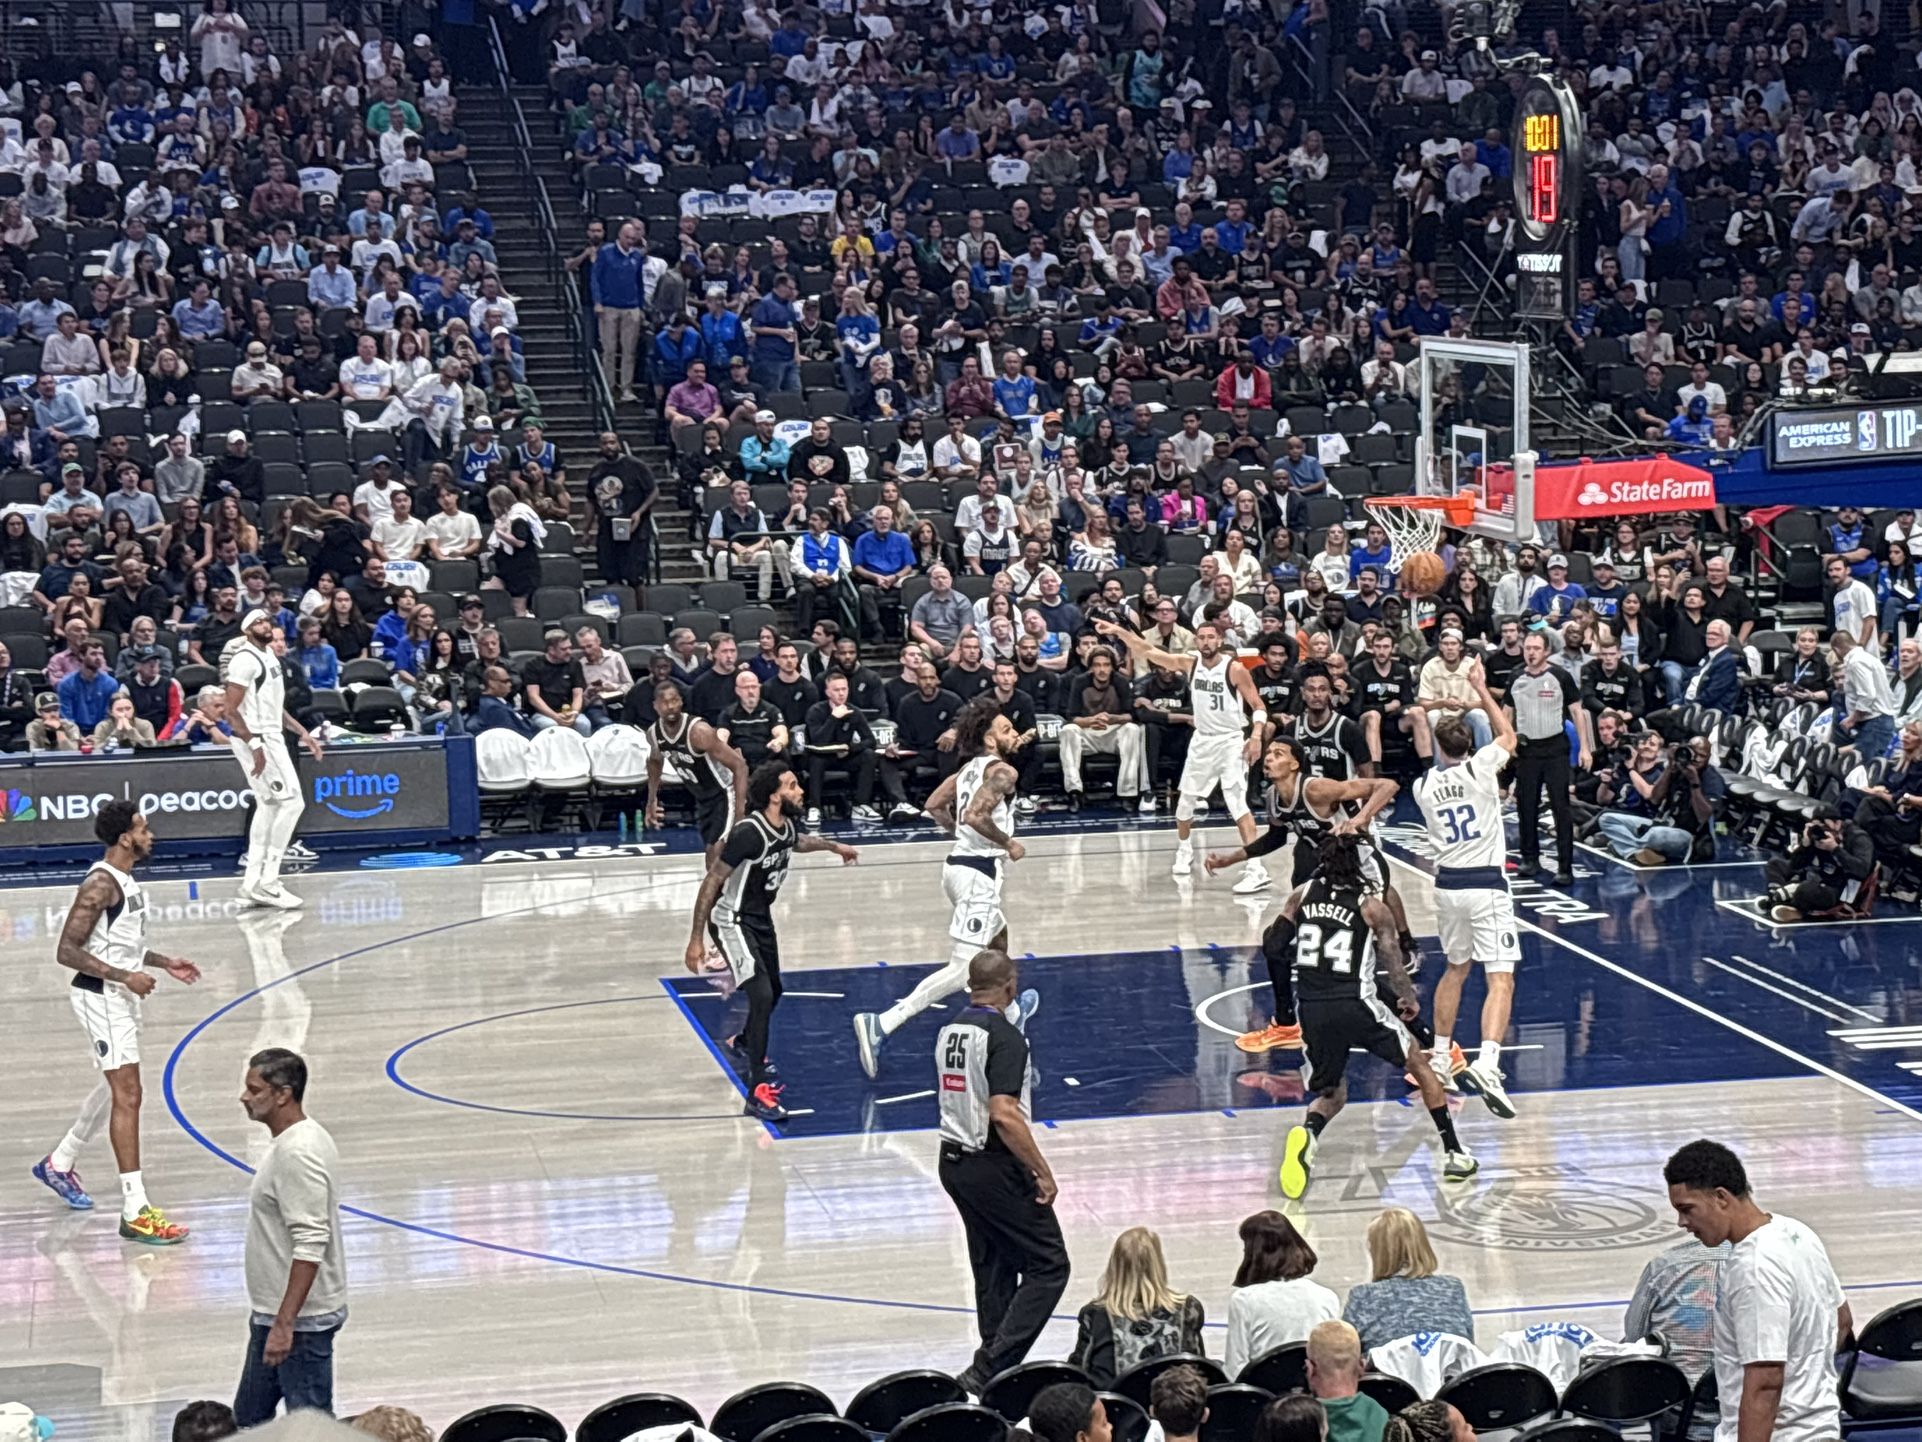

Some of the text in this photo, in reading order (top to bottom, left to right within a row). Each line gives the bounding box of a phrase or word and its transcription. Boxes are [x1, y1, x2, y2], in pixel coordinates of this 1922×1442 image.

[1533, 155, 1556, 223] 19
[1778, 421, 1852, 437] AMERICAN
[1789, 433, 1852, 449] EXPRESS
[1194, 678, 1224, 693] DALLAS
[1210, 694, 1224, 712] 31
[315, 770, 400, 803] prime
[1432, 785, 1465, 803] FLAGG
[40, 793, 114, 820] NBC
[139, 789, 256, 819] peacoc
[959, 791, 970, 826] 2
[1436, 804, 1482, 845] 32
[481, 842, 667, 863] AT&T
[1302, 902, 1355, 927] VASSELL
[1297, 923, 1354, 973] 24
[945, 1032, 970, 1069] 25
[1453, 1219, 1680, 1249] ANNIVERSAR
